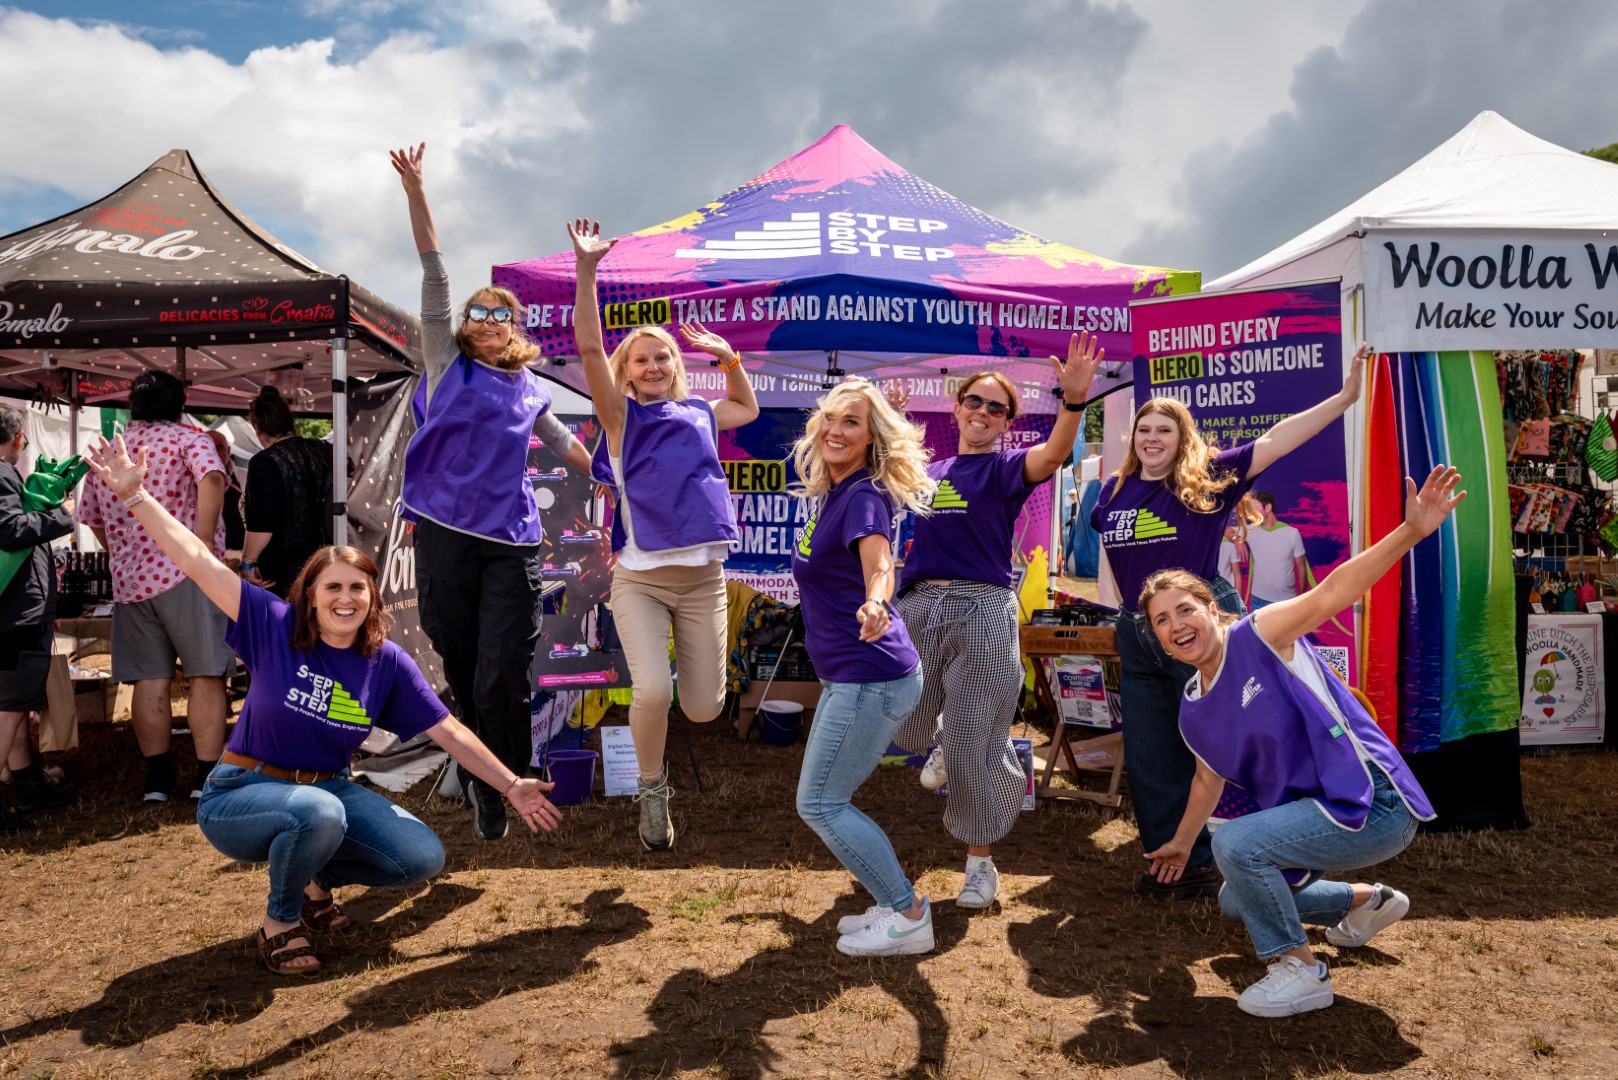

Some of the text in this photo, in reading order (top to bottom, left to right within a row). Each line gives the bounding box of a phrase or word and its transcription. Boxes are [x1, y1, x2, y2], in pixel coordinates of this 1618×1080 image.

[828, 212, 948, 233] STEP
[828, 227, 888, 242] BY
[829, 240, 955, 261] STEP
[1383, 241, 1572, 289] Woolla
[159, 309, 239, 322] DELICACIES
[270, 300, 335, 323] Croatia
[527, 303, 554, 328] BE
[609, 299, 667, 325] HERO
[674, 298, 727, 323] TAKE
[732, 298, 746, 321] A
[751, 295, 821, 321] STAND
[825, 295, 917, 323] AGAINST
[922, 299, 993, 326] YOUTH
[999, 303, 1132, 333] HOMELESSN
[1415, 302, 1496, 329] Make
[1503, 302, 1564, 328] Your
[1149, 316, 1280, 352] BEHIND EVERY
[1153, 343, 1324, 381] HERO IS SOMEONE
[1196, 380, 1256, 408] CARES
[1203, 417, 1235, 427] MAKE
[1239, 416, 1247, 425] A
[1003, 431, 1041, 442] STEP
[724, 462, 781, 491] HERO
[731, 494, 789, 523] TAND
[1107, 509, 1137, 521] STEP
[1103, 529, 1133, 542] STEP
[1116, 519, 1134, 529] BY
[1550, 628, 1578, 646] DITCH
[1576, 643, 1592, 664] THE
[1561, 645, 1584, 692] HANDMADE
[286, 687, 328, 713] STEP
[312, 687, 331, 702] BY
